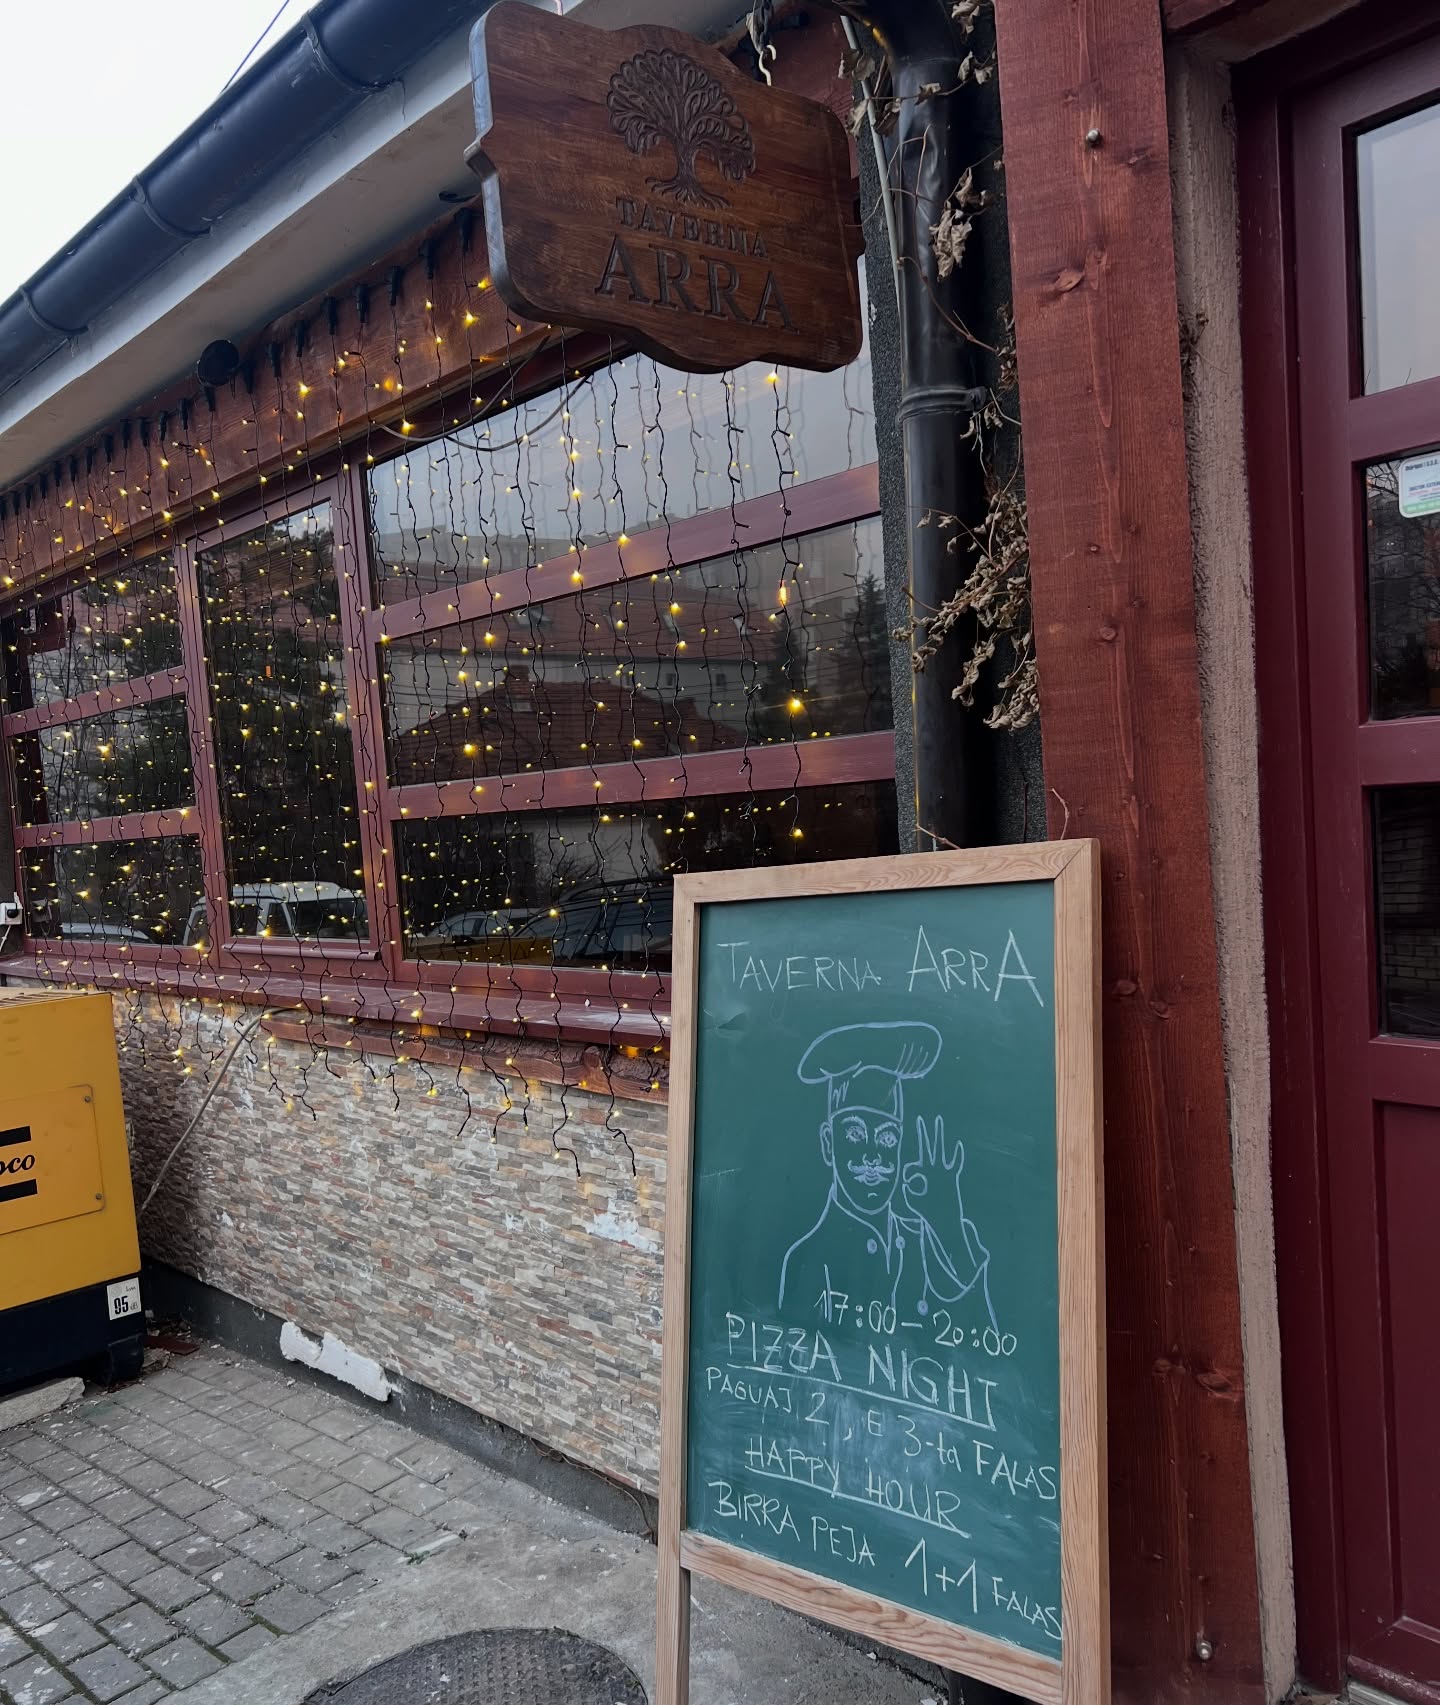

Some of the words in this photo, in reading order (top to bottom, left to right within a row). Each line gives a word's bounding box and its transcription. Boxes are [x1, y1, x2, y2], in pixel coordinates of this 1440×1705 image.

[616, 196, 768, 257] TAVERNA
[594, 233, 800, 334] ARRA
[717, 941, 882, 992] TAVERNA
[906, 925, 1044, 1007] ARRA
[114, 1295, 129, 1315] 95
[726, 1312, 842, 1382] PIZZA
[868, 1343, 999, 1431] NIGHT
[705, 1366, 792, 1413] PAGUAJ
[867, 1409, 883, 1437] E
[972, 1439, 1057, 1500] FALAS
[745, 1437, 840, 1498] HAPPY
[865, 1466, 961, 1530] HOUR
[708, 1480, 801, 1542] BIRRA
[810, 1516, 876, 1567] PEJA
[904, 1537, 978, 1614] 1+1
[991, 1576, 1063, 1640] FALAS
